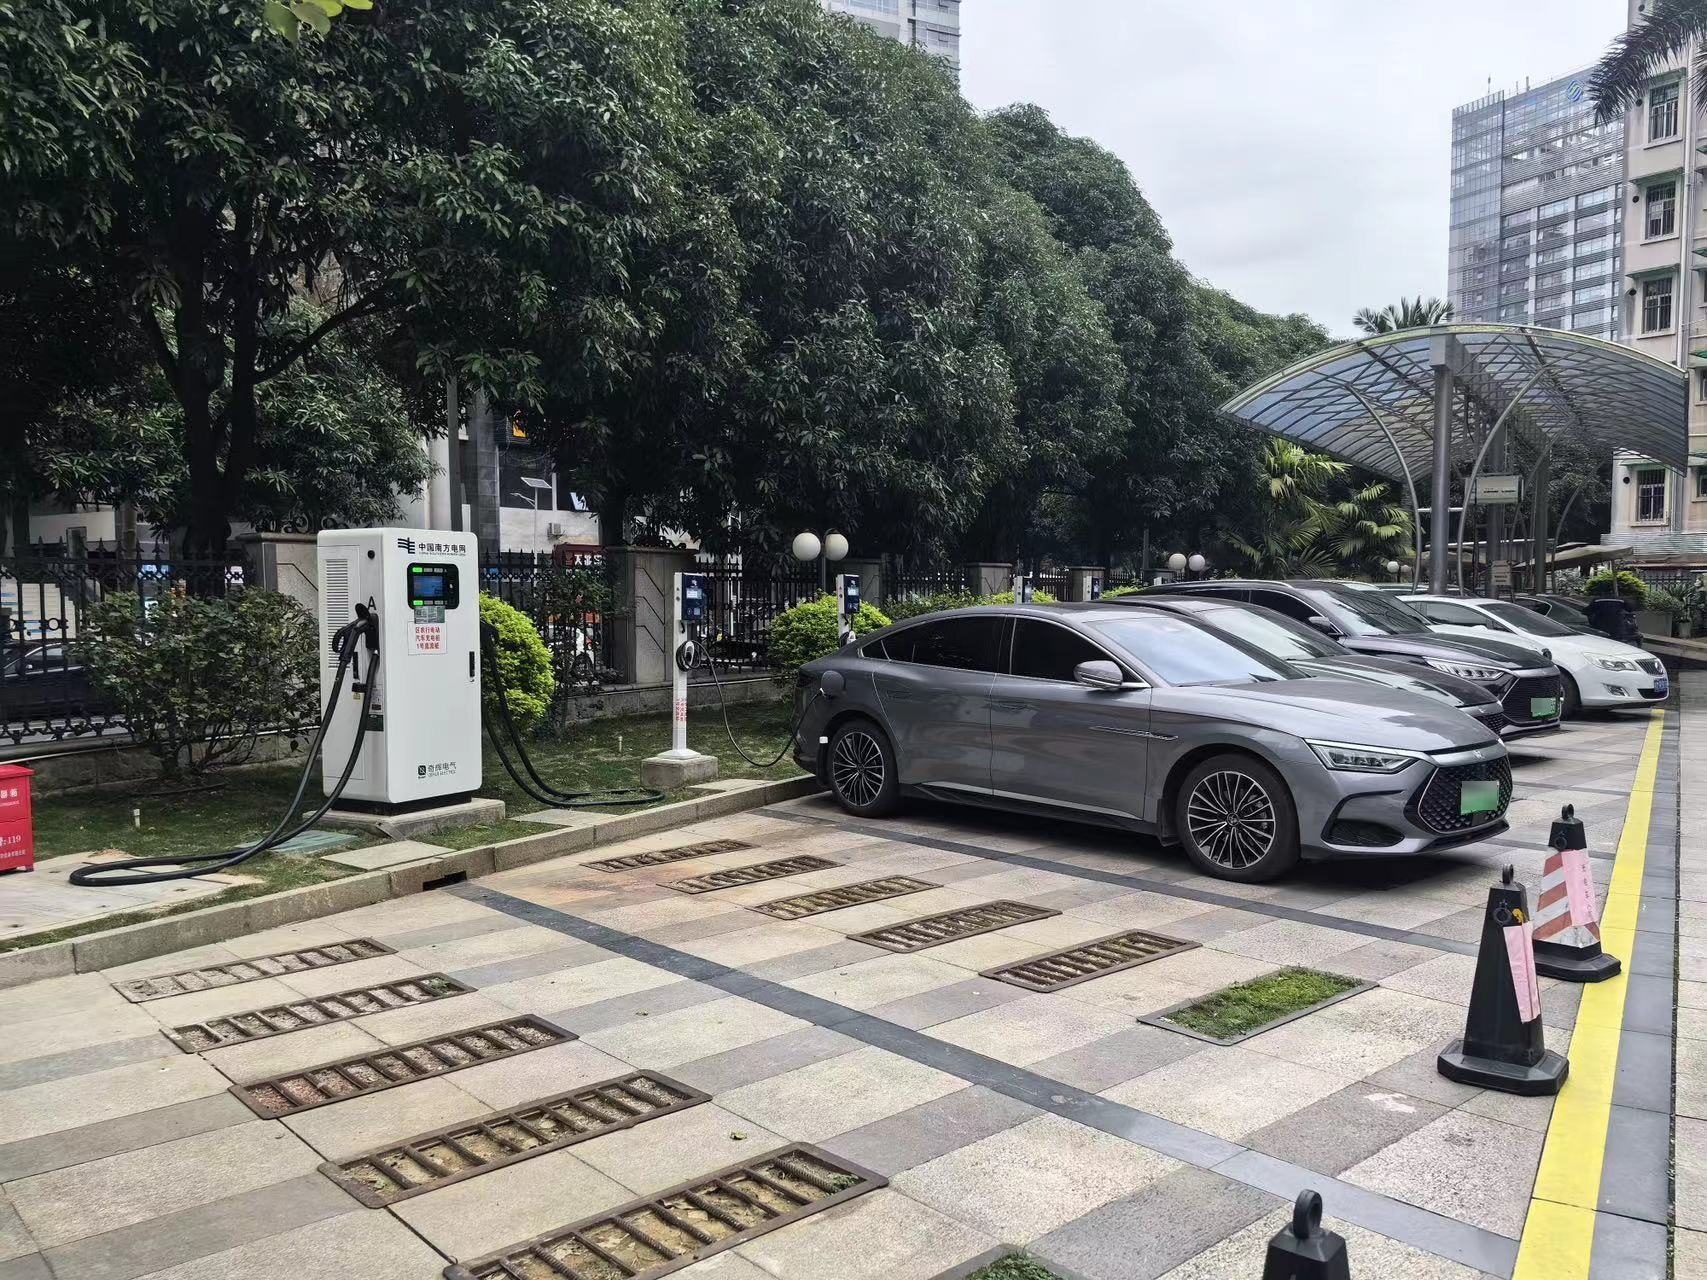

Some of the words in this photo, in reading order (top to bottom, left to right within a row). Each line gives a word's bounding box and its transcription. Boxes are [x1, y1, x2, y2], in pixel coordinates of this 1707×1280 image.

[418, 543, 466, 553] 中国南方电网
[368, 596, 377, 611] A
